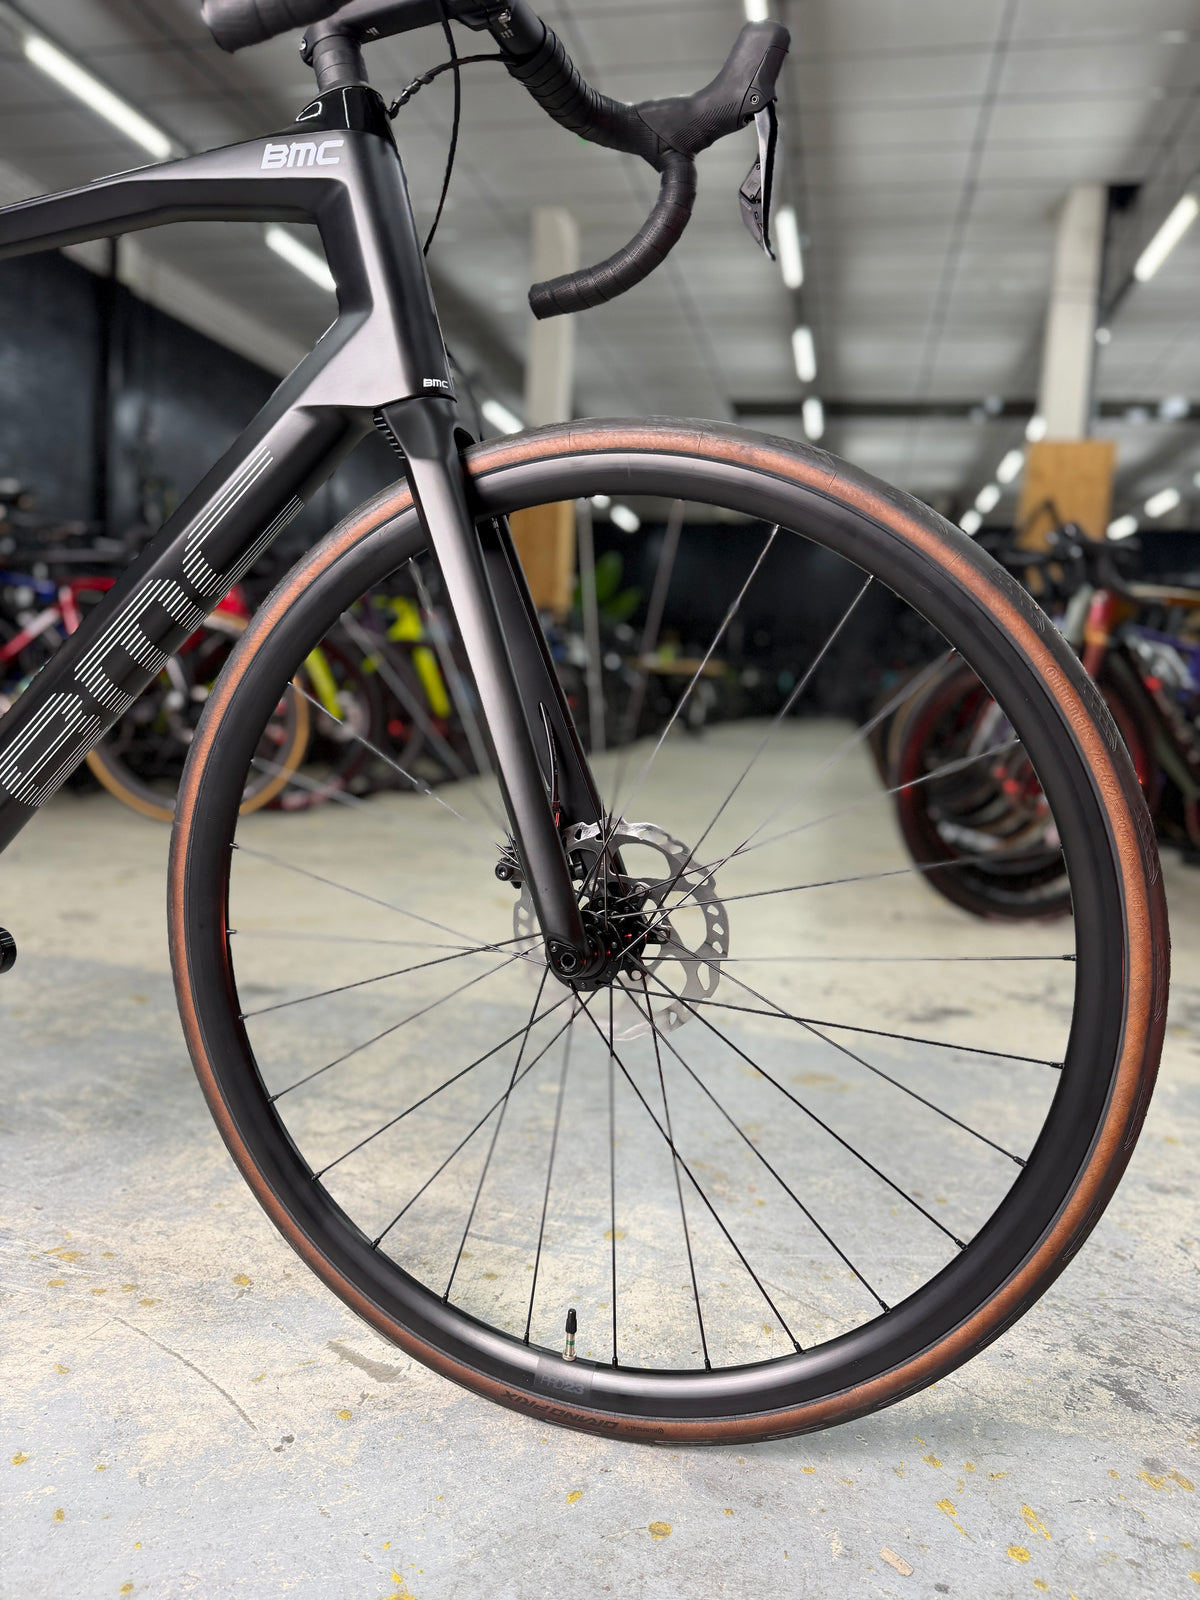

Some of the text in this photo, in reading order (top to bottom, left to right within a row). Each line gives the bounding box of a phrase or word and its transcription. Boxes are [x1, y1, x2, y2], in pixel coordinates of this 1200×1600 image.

[261, 140, 344, 169] BMC
[423, 378, 449, 389] BMC
[1044, 666, 1091, 732] Continental
[501, 1390, 550, 1413] PRIX
[550, 1408, 618, 1430] GRAND
